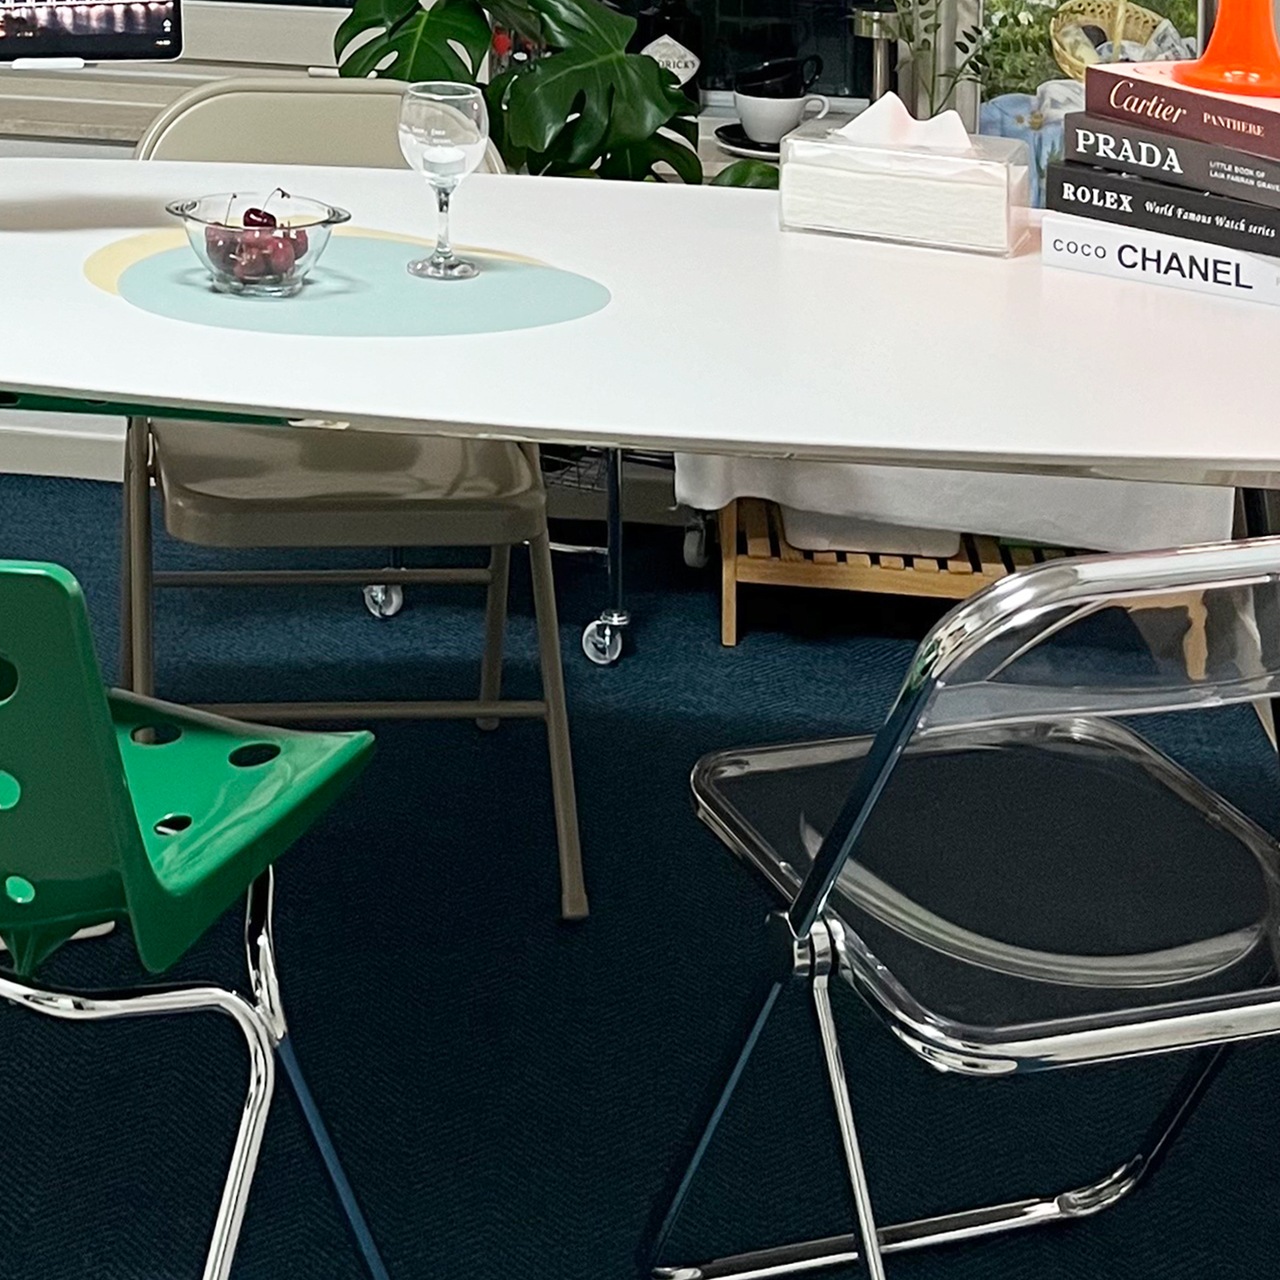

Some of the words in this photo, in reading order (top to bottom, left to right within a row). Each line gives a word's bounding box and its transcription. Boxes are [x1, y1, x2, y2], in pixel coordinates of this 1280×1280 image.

[1109, 79, 1187, 124] Cartier
[1075, 128, 1183, 174] PRADA
[1209, 160, 1233, 172] LITTLE
[1234, 165, 1254, 176] BOOK
[1255, 170, 1266, 179] OF
[1062, 182, 1134, 213] ROLEX
[1144, 200, 1175, 218] World
[1176, 206, 1212, 225] Famous
[1214, 214, 1246, 232] Watch
[1247, 223, 1276, 238] series
[1053, 238, 1107, 260] COCO
[1117, 243, 1253, 290] CHANEL
